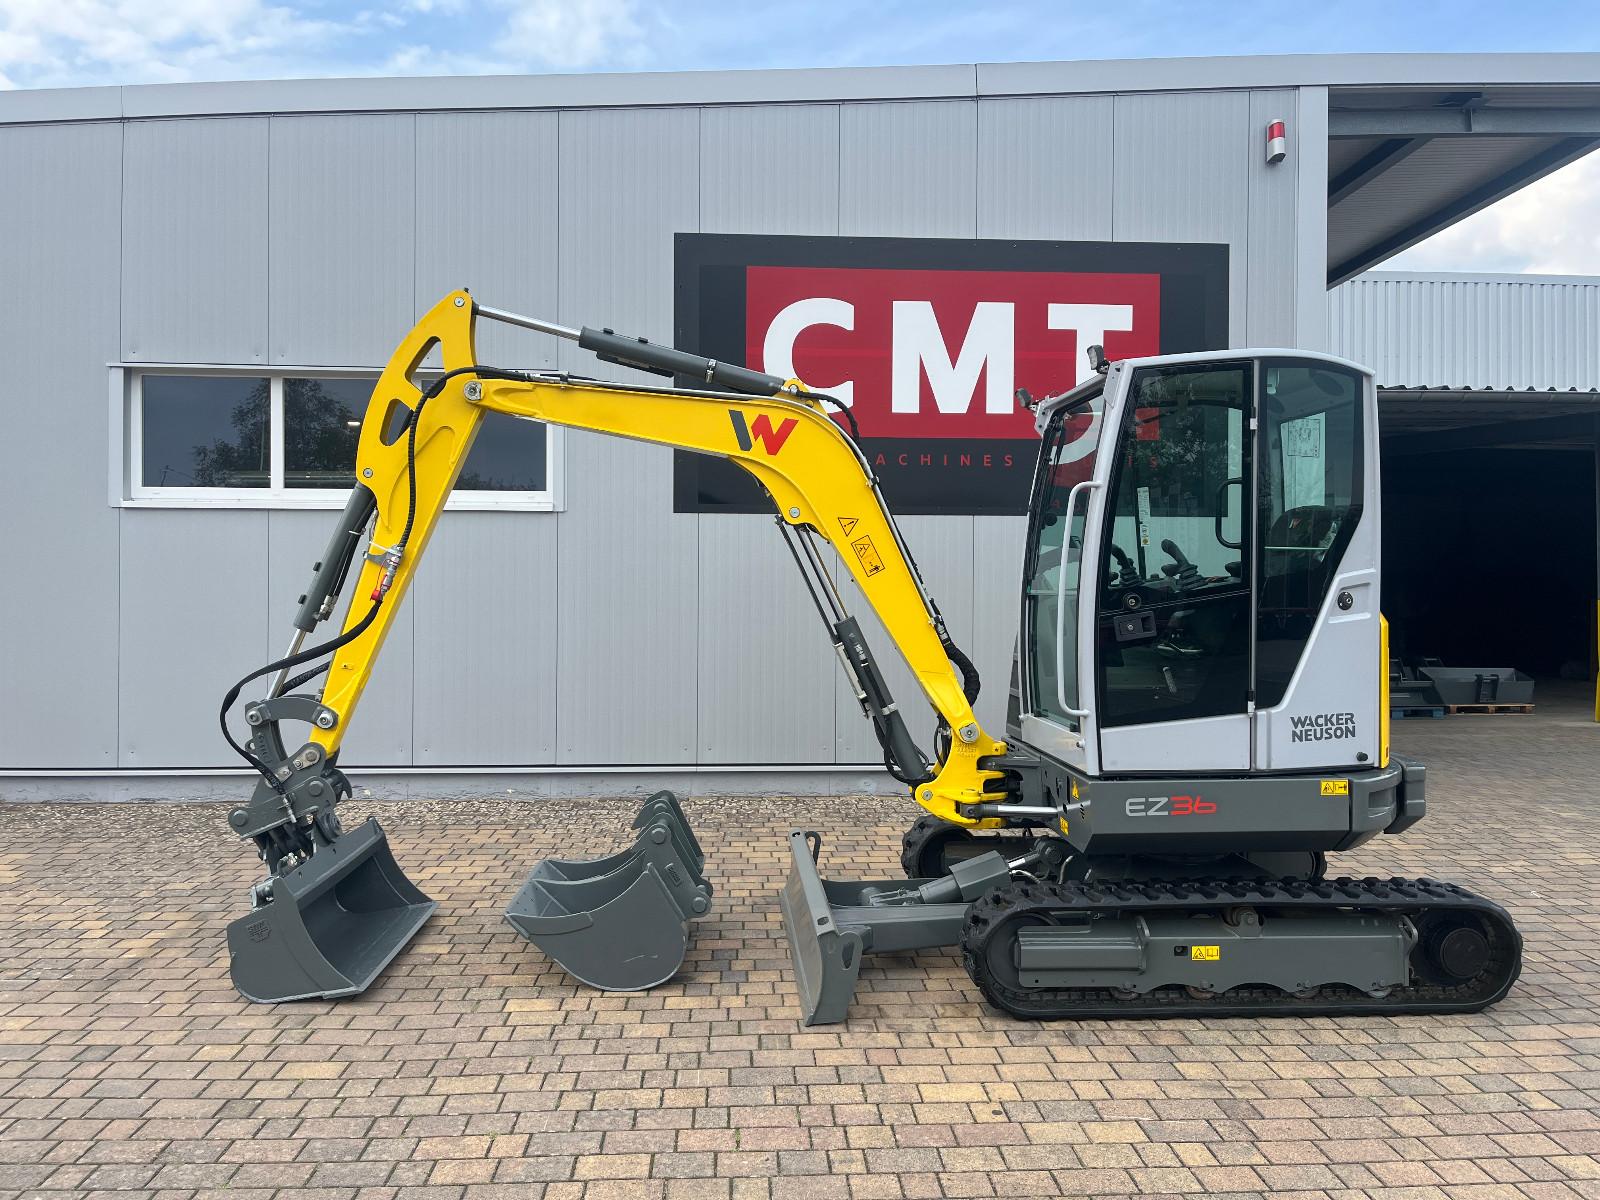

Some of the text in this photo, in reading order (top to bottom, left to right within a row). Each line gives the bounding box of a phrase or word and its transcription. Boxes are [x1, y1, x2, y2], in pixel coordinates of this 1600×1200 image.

[875, 453, 1014, 467] ACHINES
[1290, 712, 1356, 730] WACKER
[1292, 726, 1356, 743] NEUSON
[1125, 796, 1218, 817] EZ36
